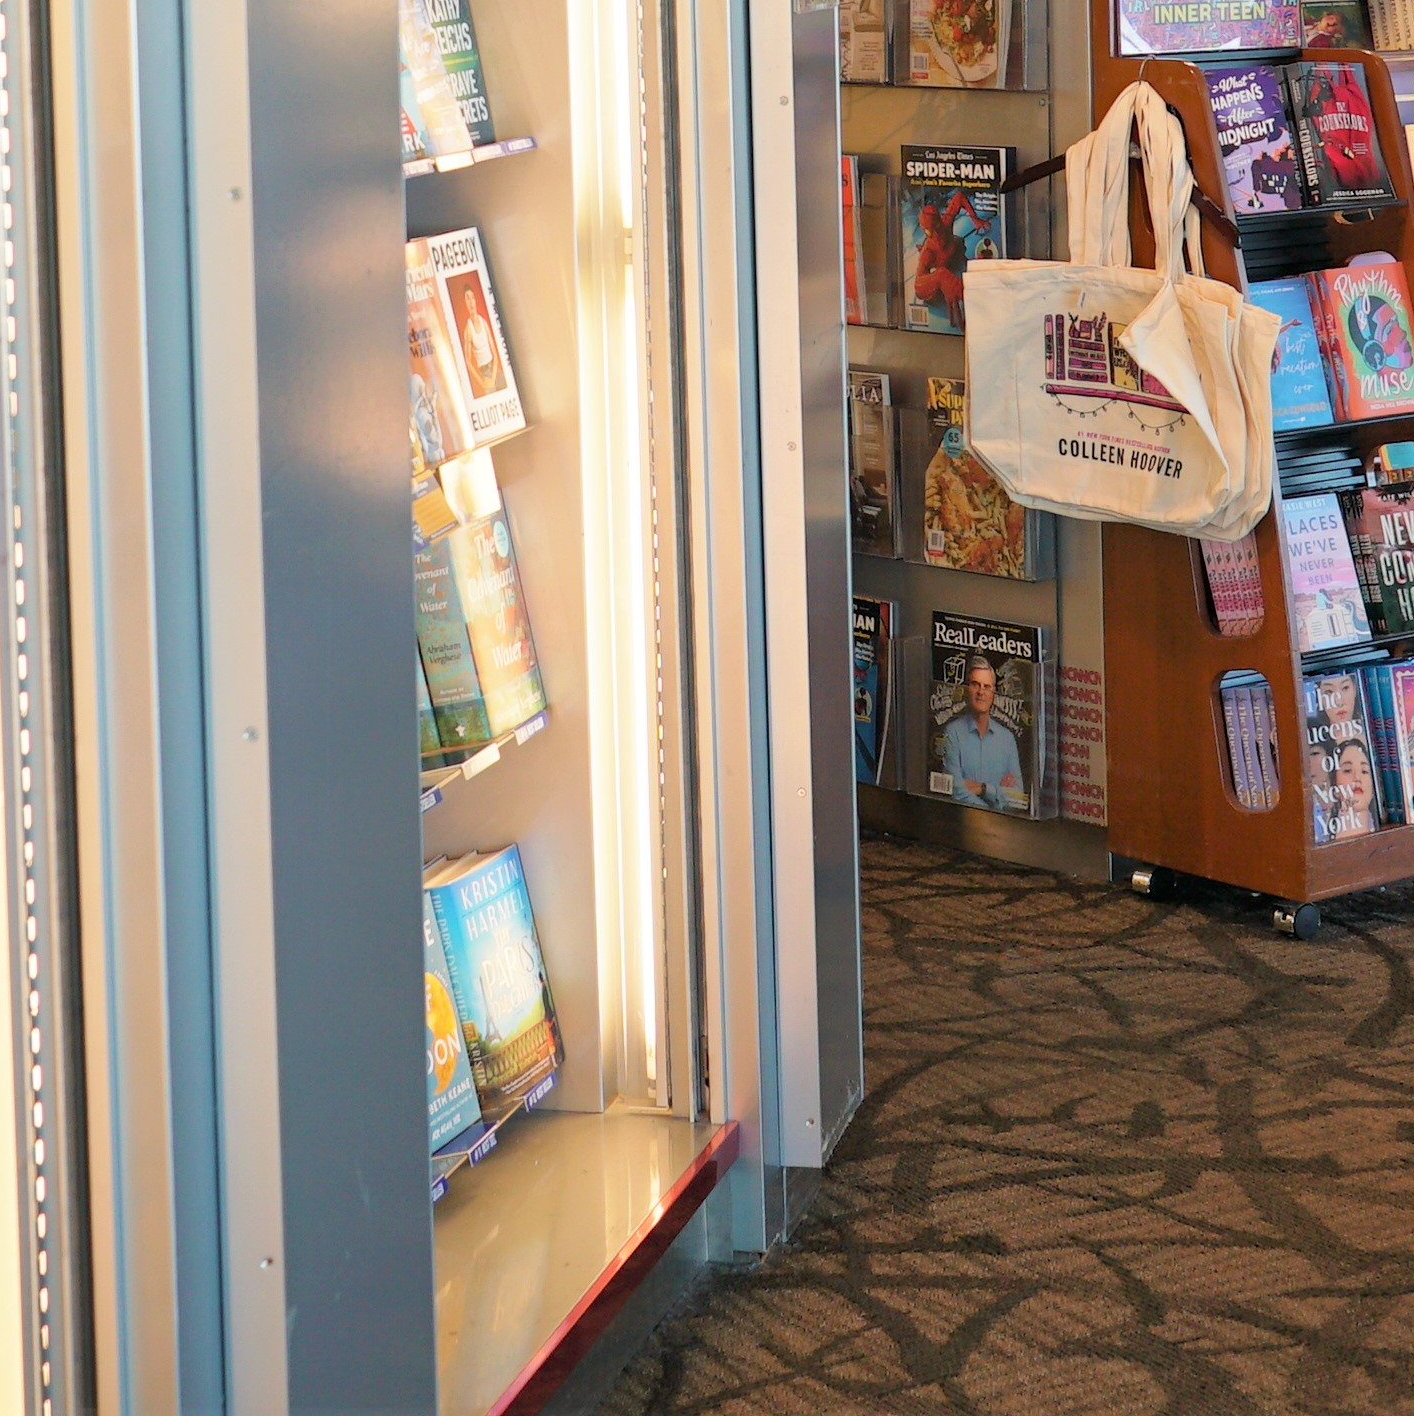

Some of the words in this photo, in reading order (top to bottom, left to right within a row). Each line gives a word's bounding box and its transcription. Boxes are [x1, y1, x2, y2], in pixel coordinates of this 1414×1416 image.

[1153, 2, 1213, 25] INNER
[1217, 1, 1267, 22] TEEN
[1218, 77, 1249, 93] What
[1211, 85, 1264, 112] HAPPENS
[1319, 114, 1369, 133] COUNSELORS
[907, 161, 995, 180] SPIDER-MAN
[431, 236, 480, 273] PAGEBOY
[1334, 270, 1403, 313] Rhythm
[948, 432, 959, 443] 65
[1058, 438, 1125, 467] COLLEEN
[1130, 450, 1183, 479] HOOVER
[1288, 515, 1337, 535] LACES
[1290, 537, 1337, 557] WE'VE
[1299, 558, 1334, 572] NEVER
[1308, 574, 1333, 586] BEEN
[420, 600, 448, 614] Water
[934, 622, 1032, 658] RealLeaders
[491, 640, 523, 670] Water
[1305, 688, 1341, 713] The
[1321, 748, 1341, 773] of
[1314, 782, 1356, 804] New
[1317, 808, 1363, 836] York
[460, 857, 519, 911] KRISTIN
[465, 887, 527, 942] HARMEL
[482, 935, 535, 1000] PARIS
